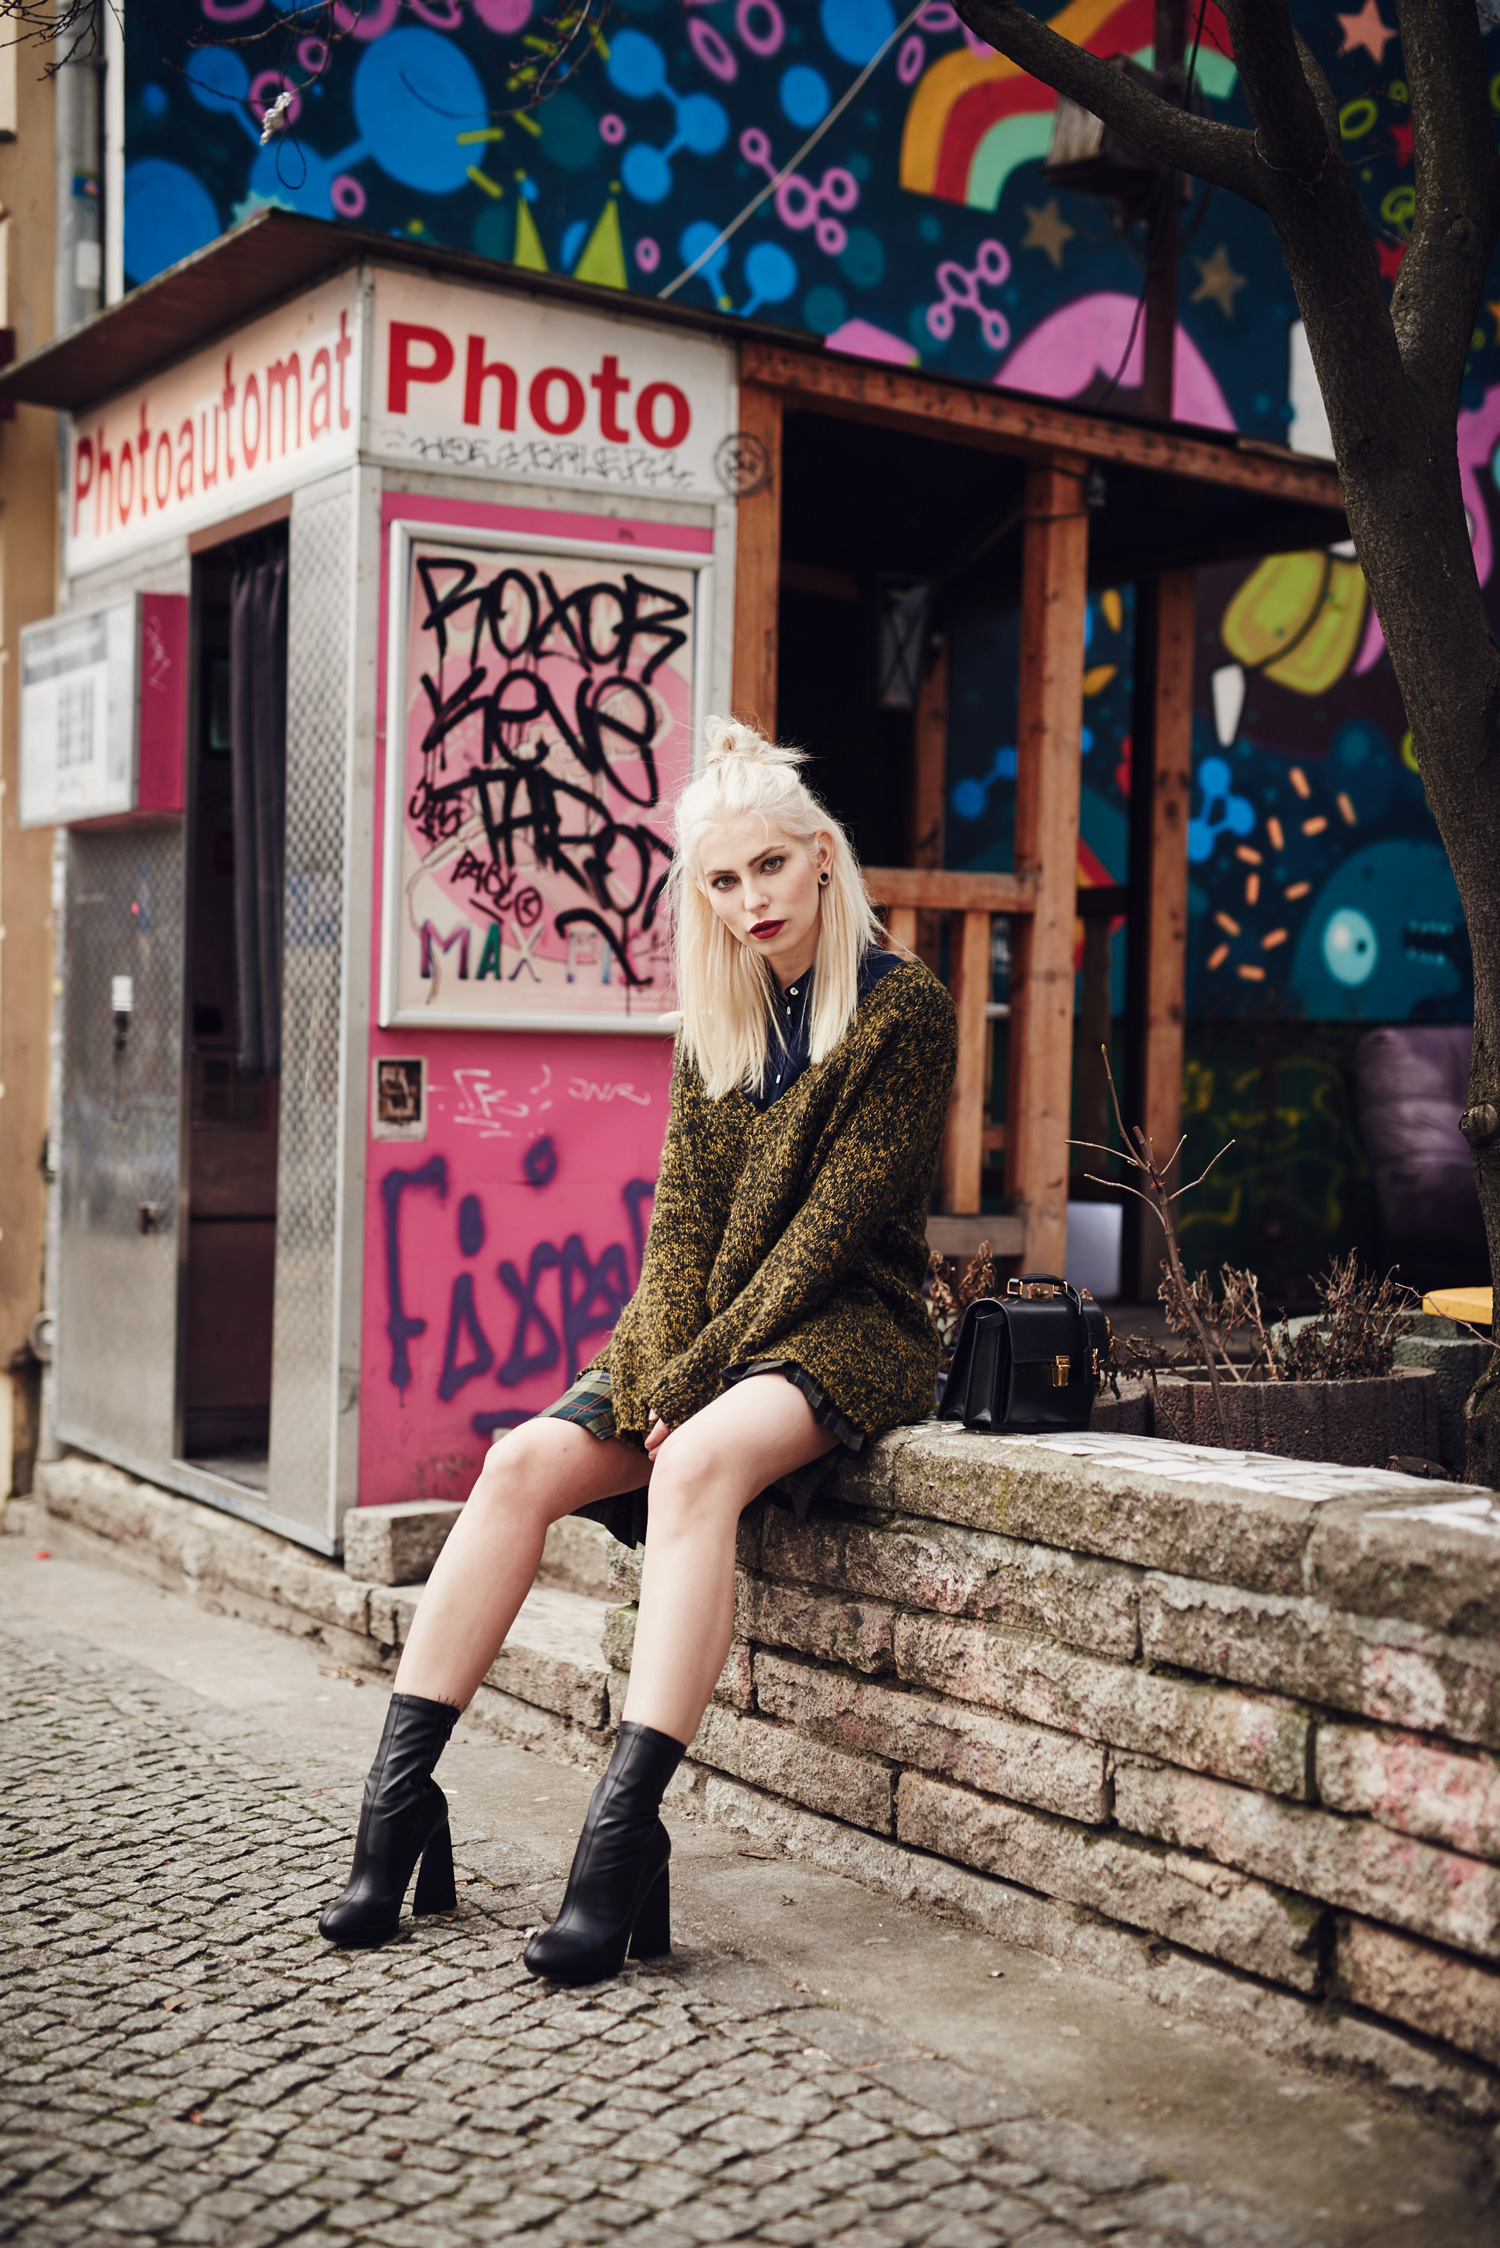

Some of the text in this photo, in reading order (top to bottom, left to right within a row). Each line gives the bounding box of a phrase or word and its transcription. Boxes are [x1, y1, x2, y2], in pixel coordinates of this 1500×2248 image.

[73, 309, 352, 538] Photoautomat
[386, 320, 692, 450] Photo
[420, 919, 545, 983] MAX
